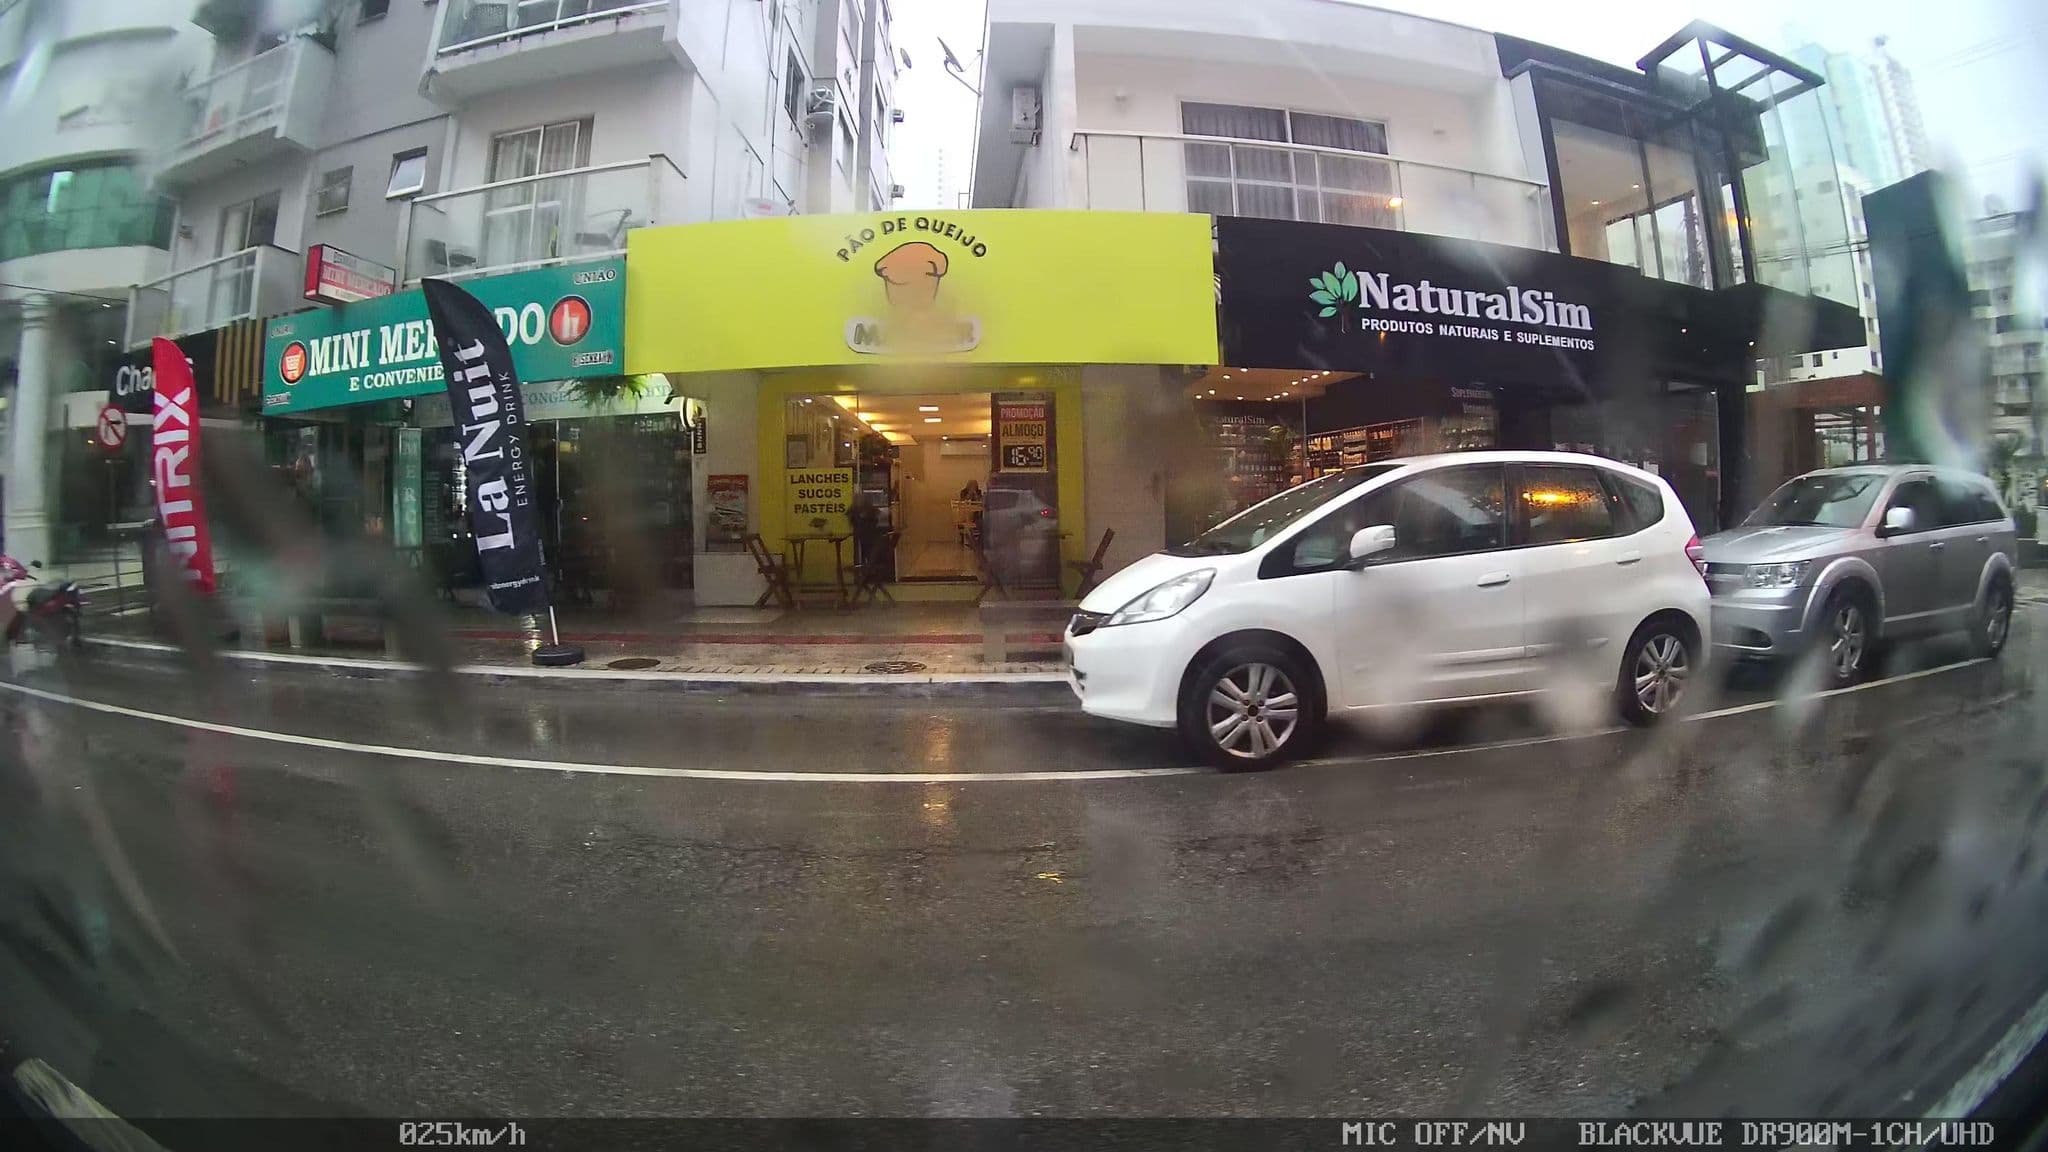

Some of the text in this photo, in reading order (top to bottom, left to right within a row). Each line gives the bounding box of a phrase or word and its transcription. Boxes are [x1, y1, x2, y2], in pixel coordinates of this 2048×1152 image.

[837, 217, 987, 262] PÃO DE QUEIJO
[1356, 271, 1593, 331] NaturalSim
[1361, 318, 1595, 351] PRODUTOS NATURAIS E SUPLEMENTOS
[309, 329, 371, 377] MINI
[116, 364, 157, 397] Cha
[349, 362, 444, 391] E CONVENIÊ
[453, 338, 515, 555] La Nuit
[499, 371, 529, 507] ENERGY DRINK
[1002, 423, 1044, 439] ALMOÇO
[790, 473, 849, 484] LANCHES
[798, 488, 841, 499] SUCOS
[794, 503, 846, 514] PASTEIS
